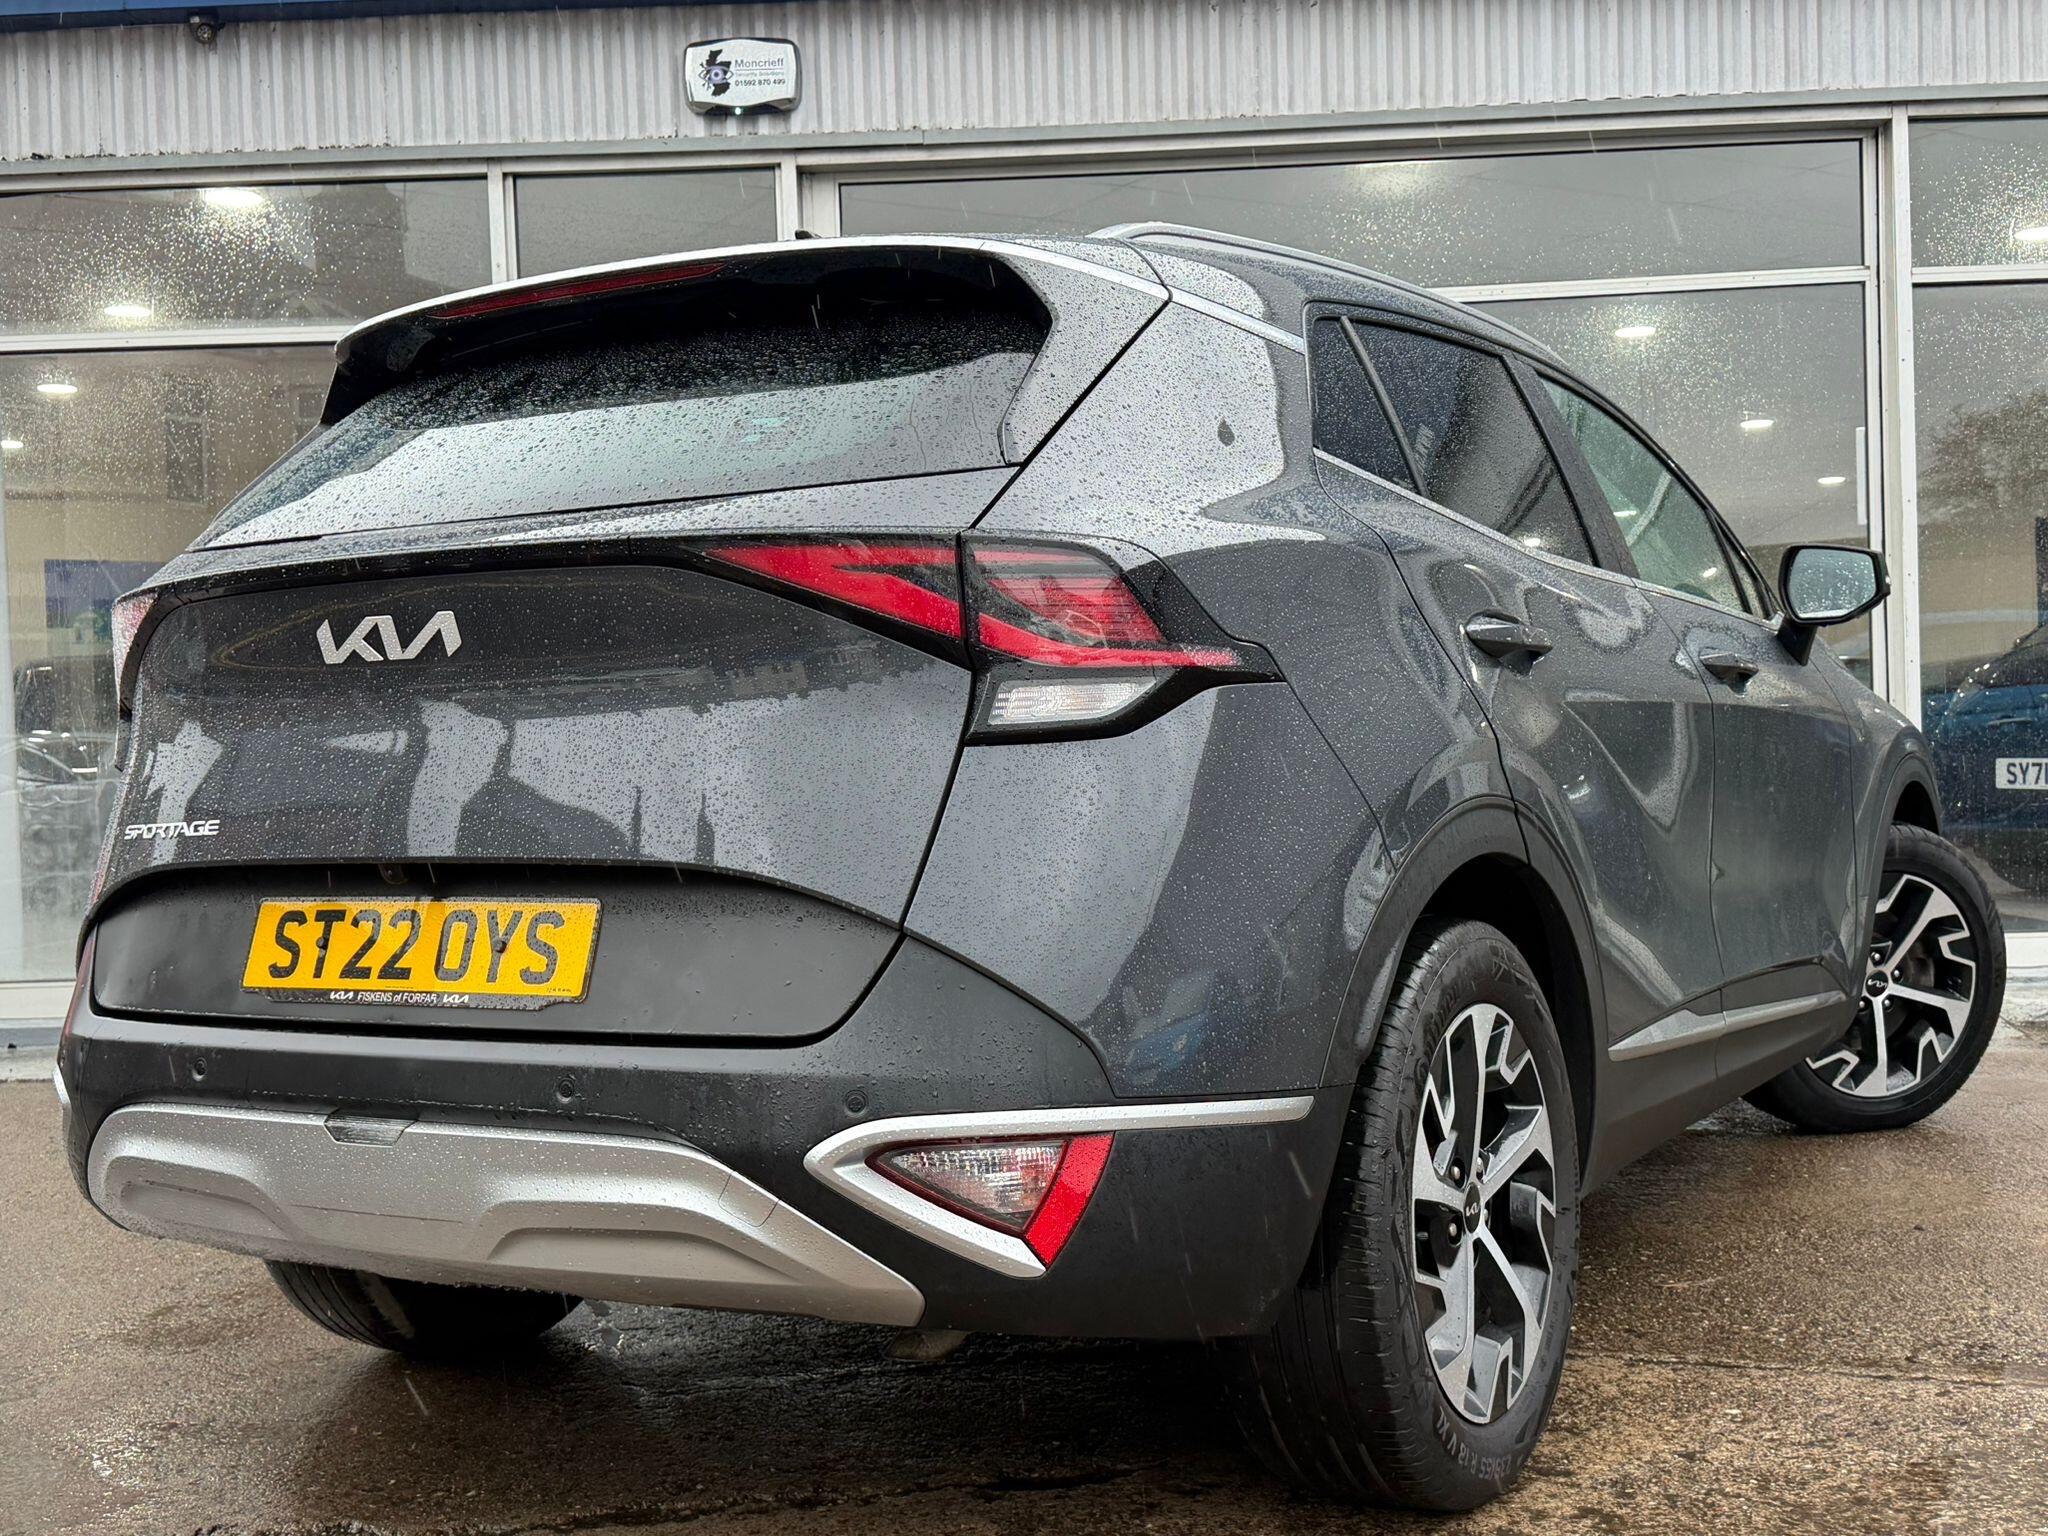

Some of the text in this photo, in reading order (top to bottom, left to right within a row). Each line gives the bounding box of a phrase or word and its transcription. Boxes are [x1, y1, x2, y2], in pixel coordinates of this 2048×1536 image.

[734, 57, 784, 68] Moncrieff
[734, 79, 757, 87] 01592
[316, 610, 462, 665] KIA
[124, 819, 221, 841] SPORTAGE
[268, 909, 566, 985] ST22 OYS
[330, 990, 470, 1004] KIA FISKENS of FORFAR KIA
